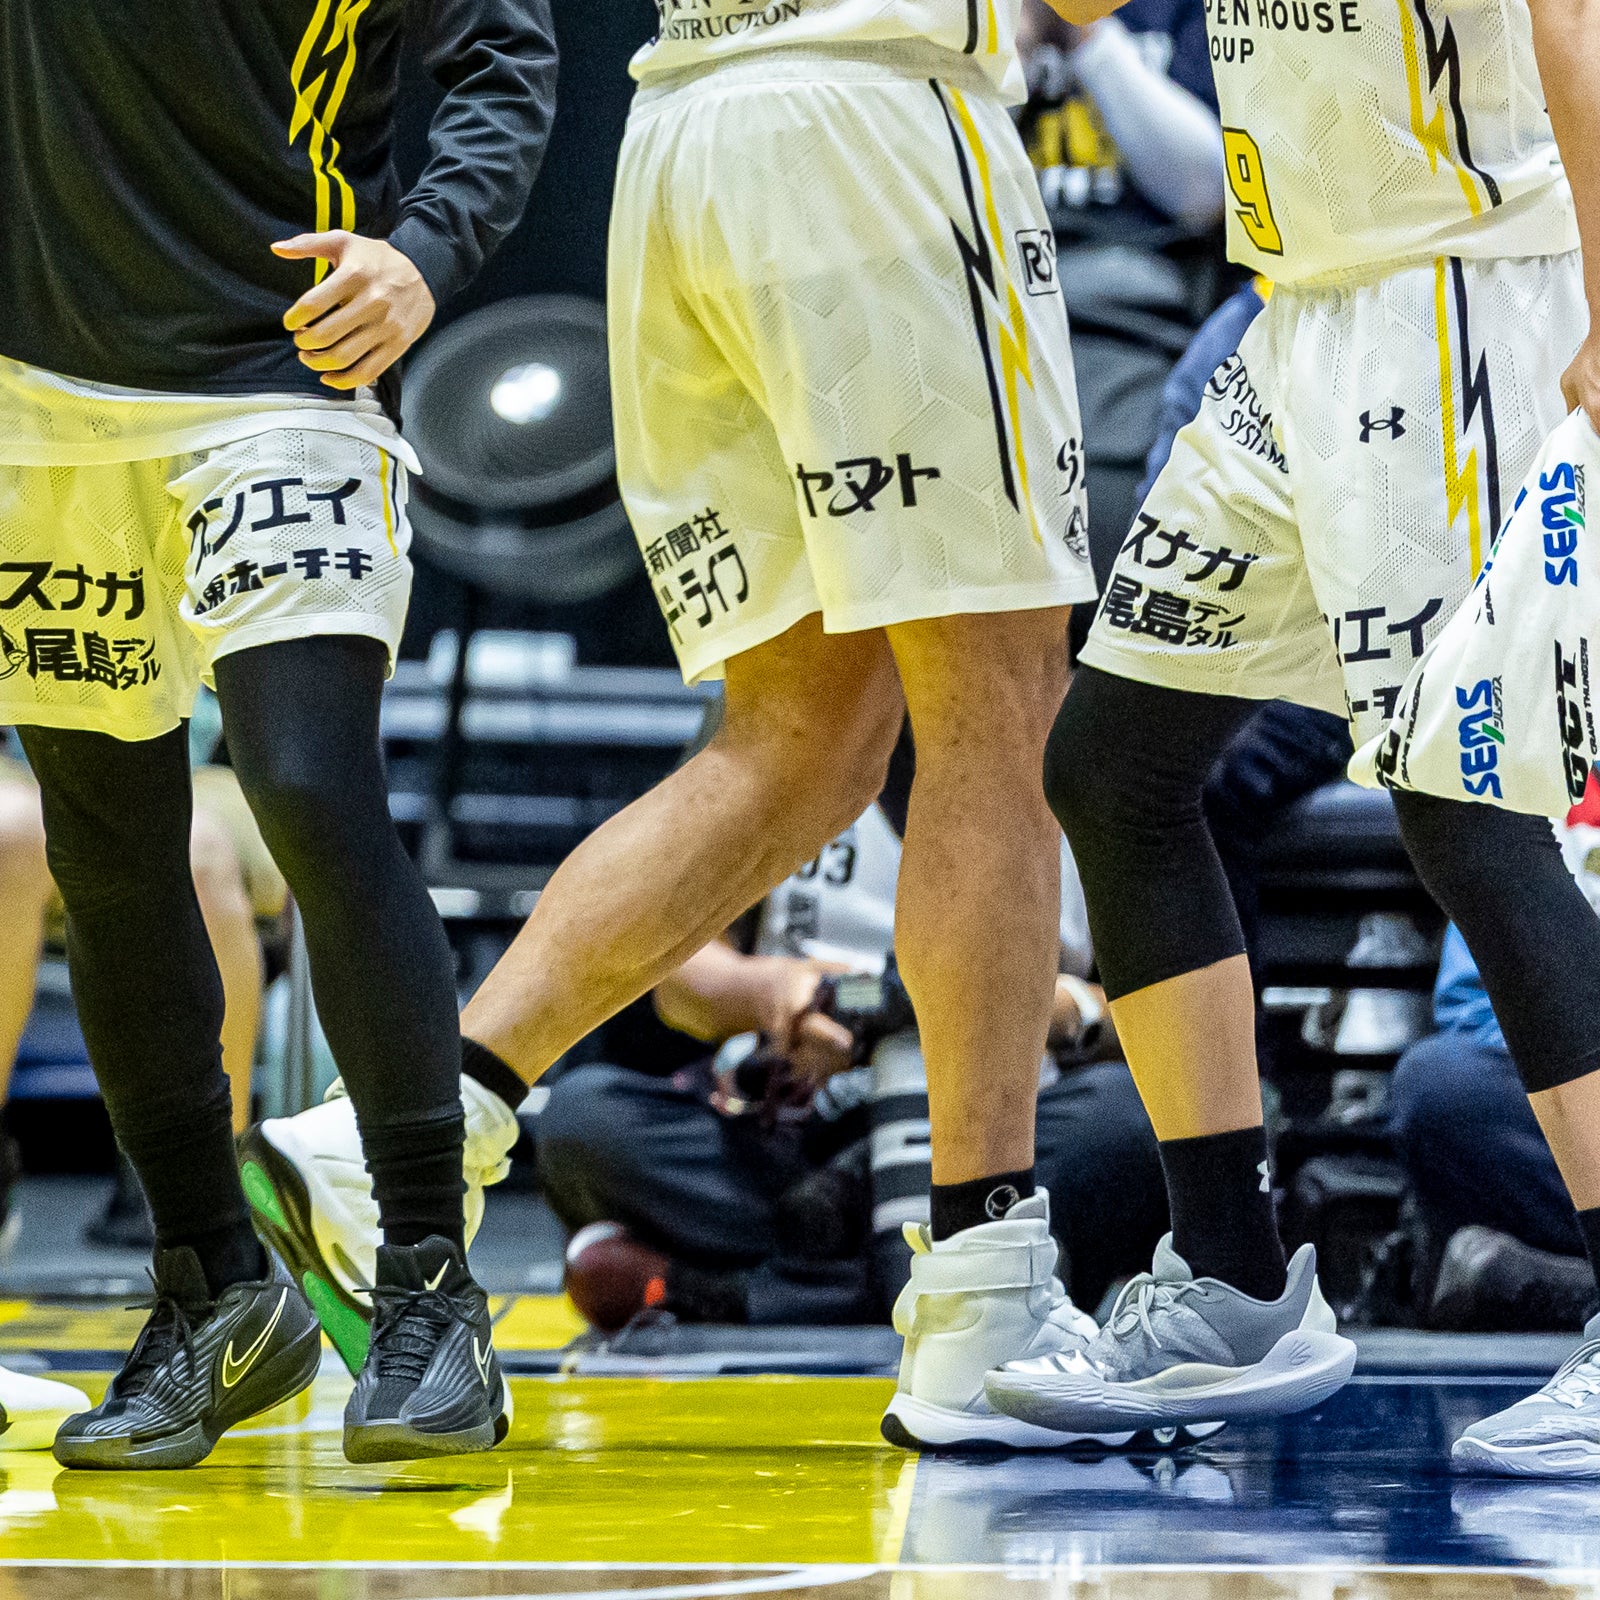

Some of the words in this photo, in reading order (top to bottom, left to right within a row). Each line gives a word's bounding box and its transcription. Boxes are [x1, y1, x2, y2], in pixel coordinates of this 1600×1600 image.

[1210, 35, 1255, 64] OUP
[1221, 126, 1284, 256] 9
[796, 453, 941, 518] ヤマト
[1539, 462, 1578, 587] SEMS
[193, 548, 374, 615] 東ホーチキ
[1120, 512, 1260, 591] スナガ
[1455, 679, 1504, 800] SEMS
